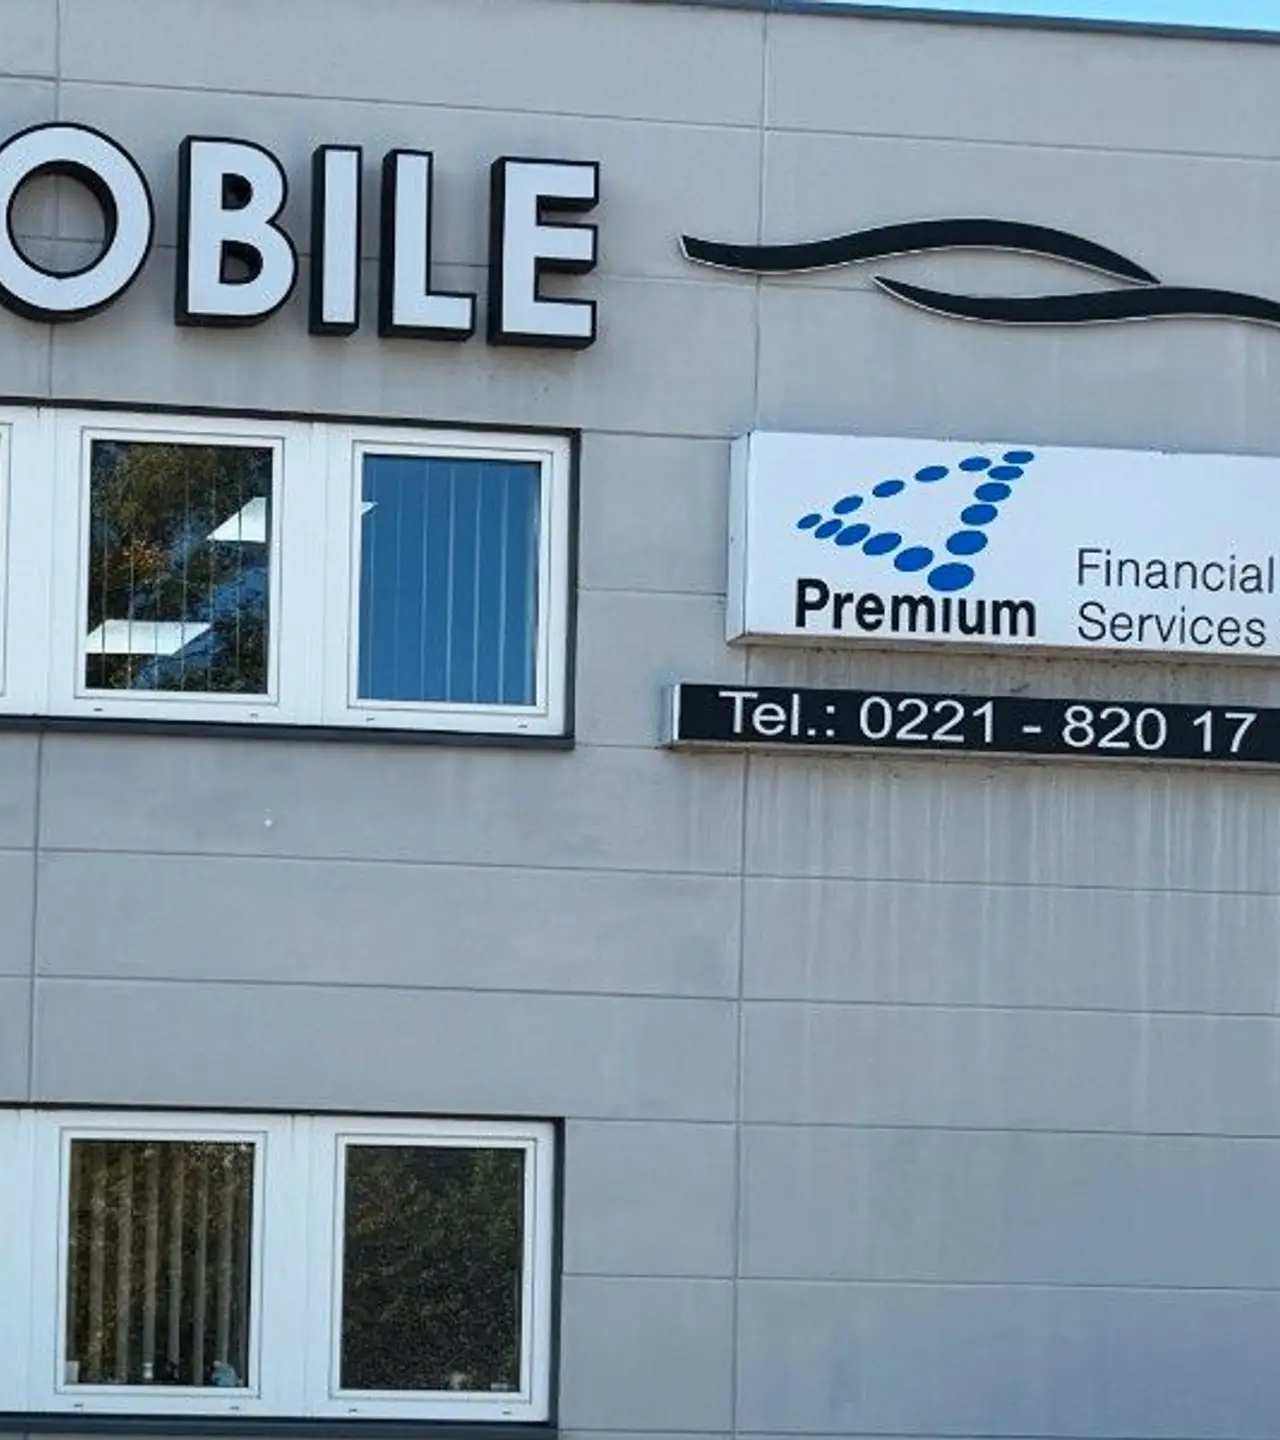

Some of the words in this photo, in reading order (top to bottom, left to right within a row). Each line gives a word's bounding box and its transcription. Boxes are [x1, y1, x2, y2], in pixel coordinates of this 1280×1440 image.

[1077, 549, 1275, 594] Financial
[795, 577, 1037, 637] Premium
[1077, 602, 1267, 648] Services
[720, 691, 835, 738] Tel.:
[860, 697, 996, 744] 0221
[1062, 706, 1167, 750] 820
[1193, 710, 1257, 753] 17
